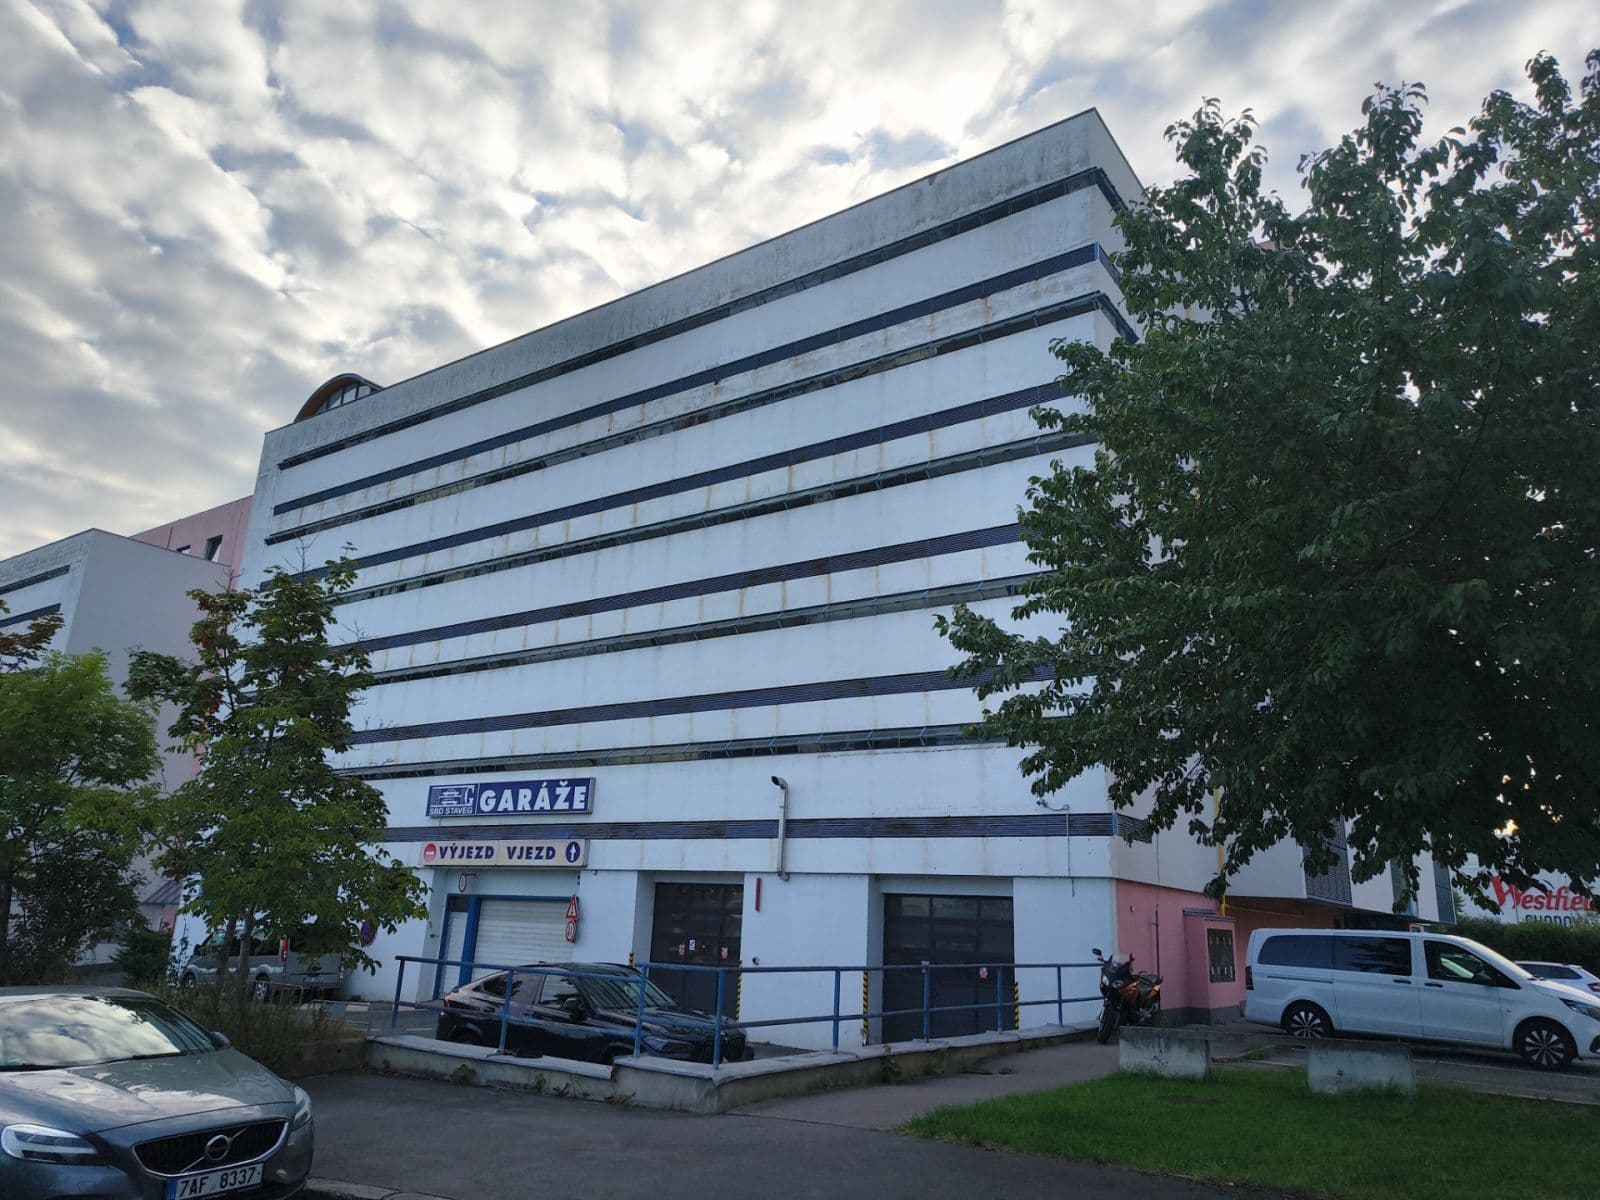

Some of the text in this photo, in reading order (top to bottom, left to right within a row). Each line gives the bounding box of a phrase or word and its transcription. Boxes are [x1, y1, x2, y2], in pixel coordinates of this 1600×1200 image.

[479, 780, 587, 812] GARÁŽE
[439, 843, 556, 861] VÝJEZD VJEZD
[180, 1176, 209, 1198] 7AF
